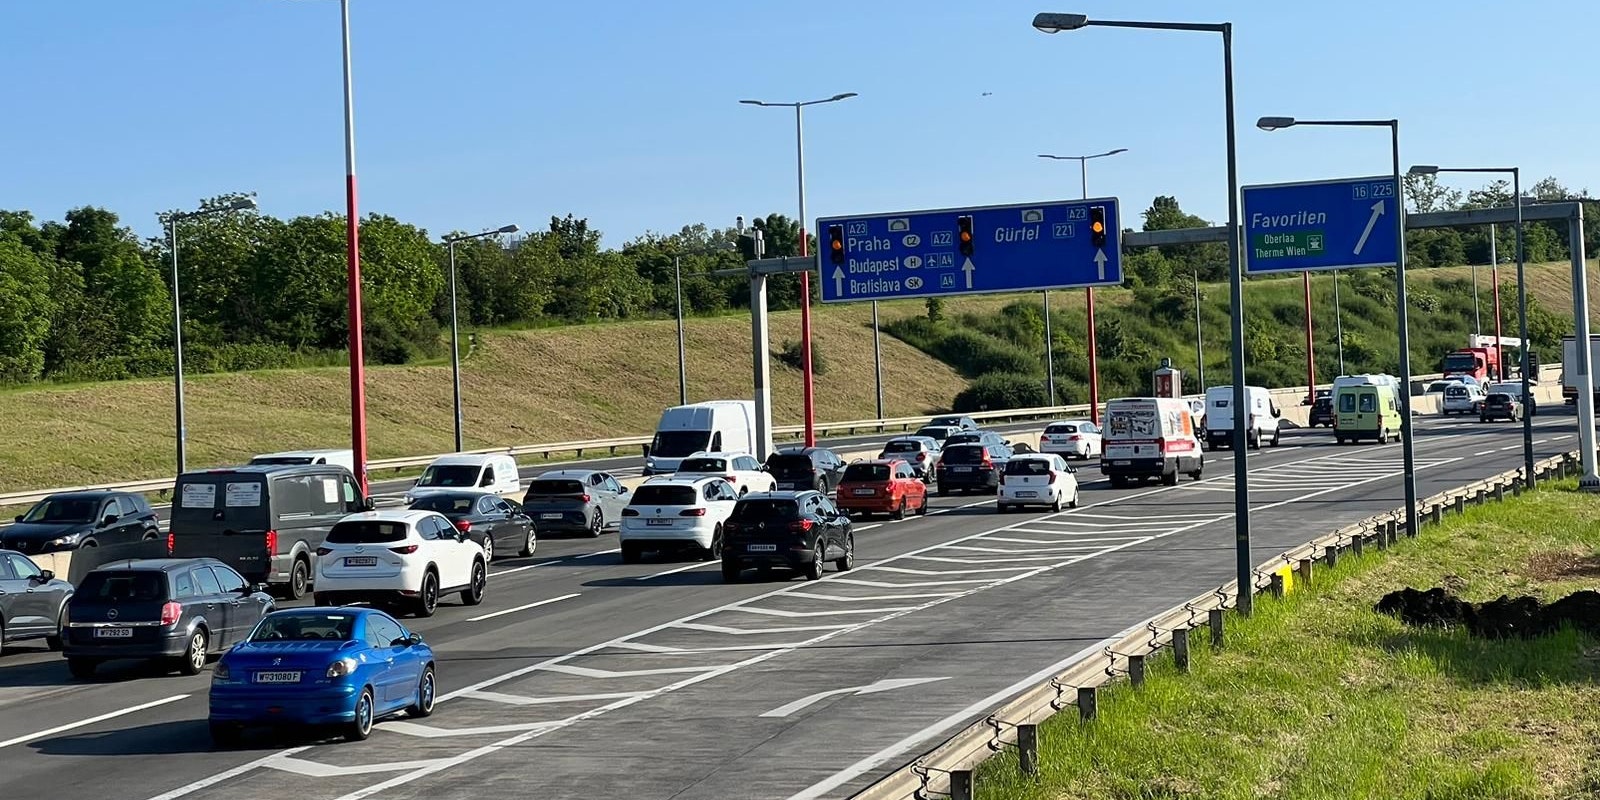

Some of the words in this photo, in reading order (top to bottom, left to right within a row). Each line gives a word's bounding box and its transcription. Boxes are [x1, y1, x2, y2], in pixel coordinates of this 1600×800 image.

[1354, 186, 1366, 198] 16
[1373, 184, 1392, 197] 225
[1069, 208, 1086, 219] A23
[1252, 211, 1326, 228] Favoriten
[849, 223, 866, 234] A23
[995, 224, 1040, 242] Gürtel
[1055, 224, 1072, 237] 221
[848, 236, 891, 252] Praha
[906, 236, 917, 246] CZ
[933, 233, 951, 245] A22
[1264, 233, 1295, 244] Oberlaa
[1255, 249, 1284, 258] Therme
[1286, 246, 1306, 256] Wien
[849, 256, 899, 275] Budapest
[910, 257, 917, 267] H
[941, 255, 952, 265] A4
[850, 278, 901, 294] Bratislava
[908, 278, 920, 288] SK
[942, 275, 953, 286] A4
